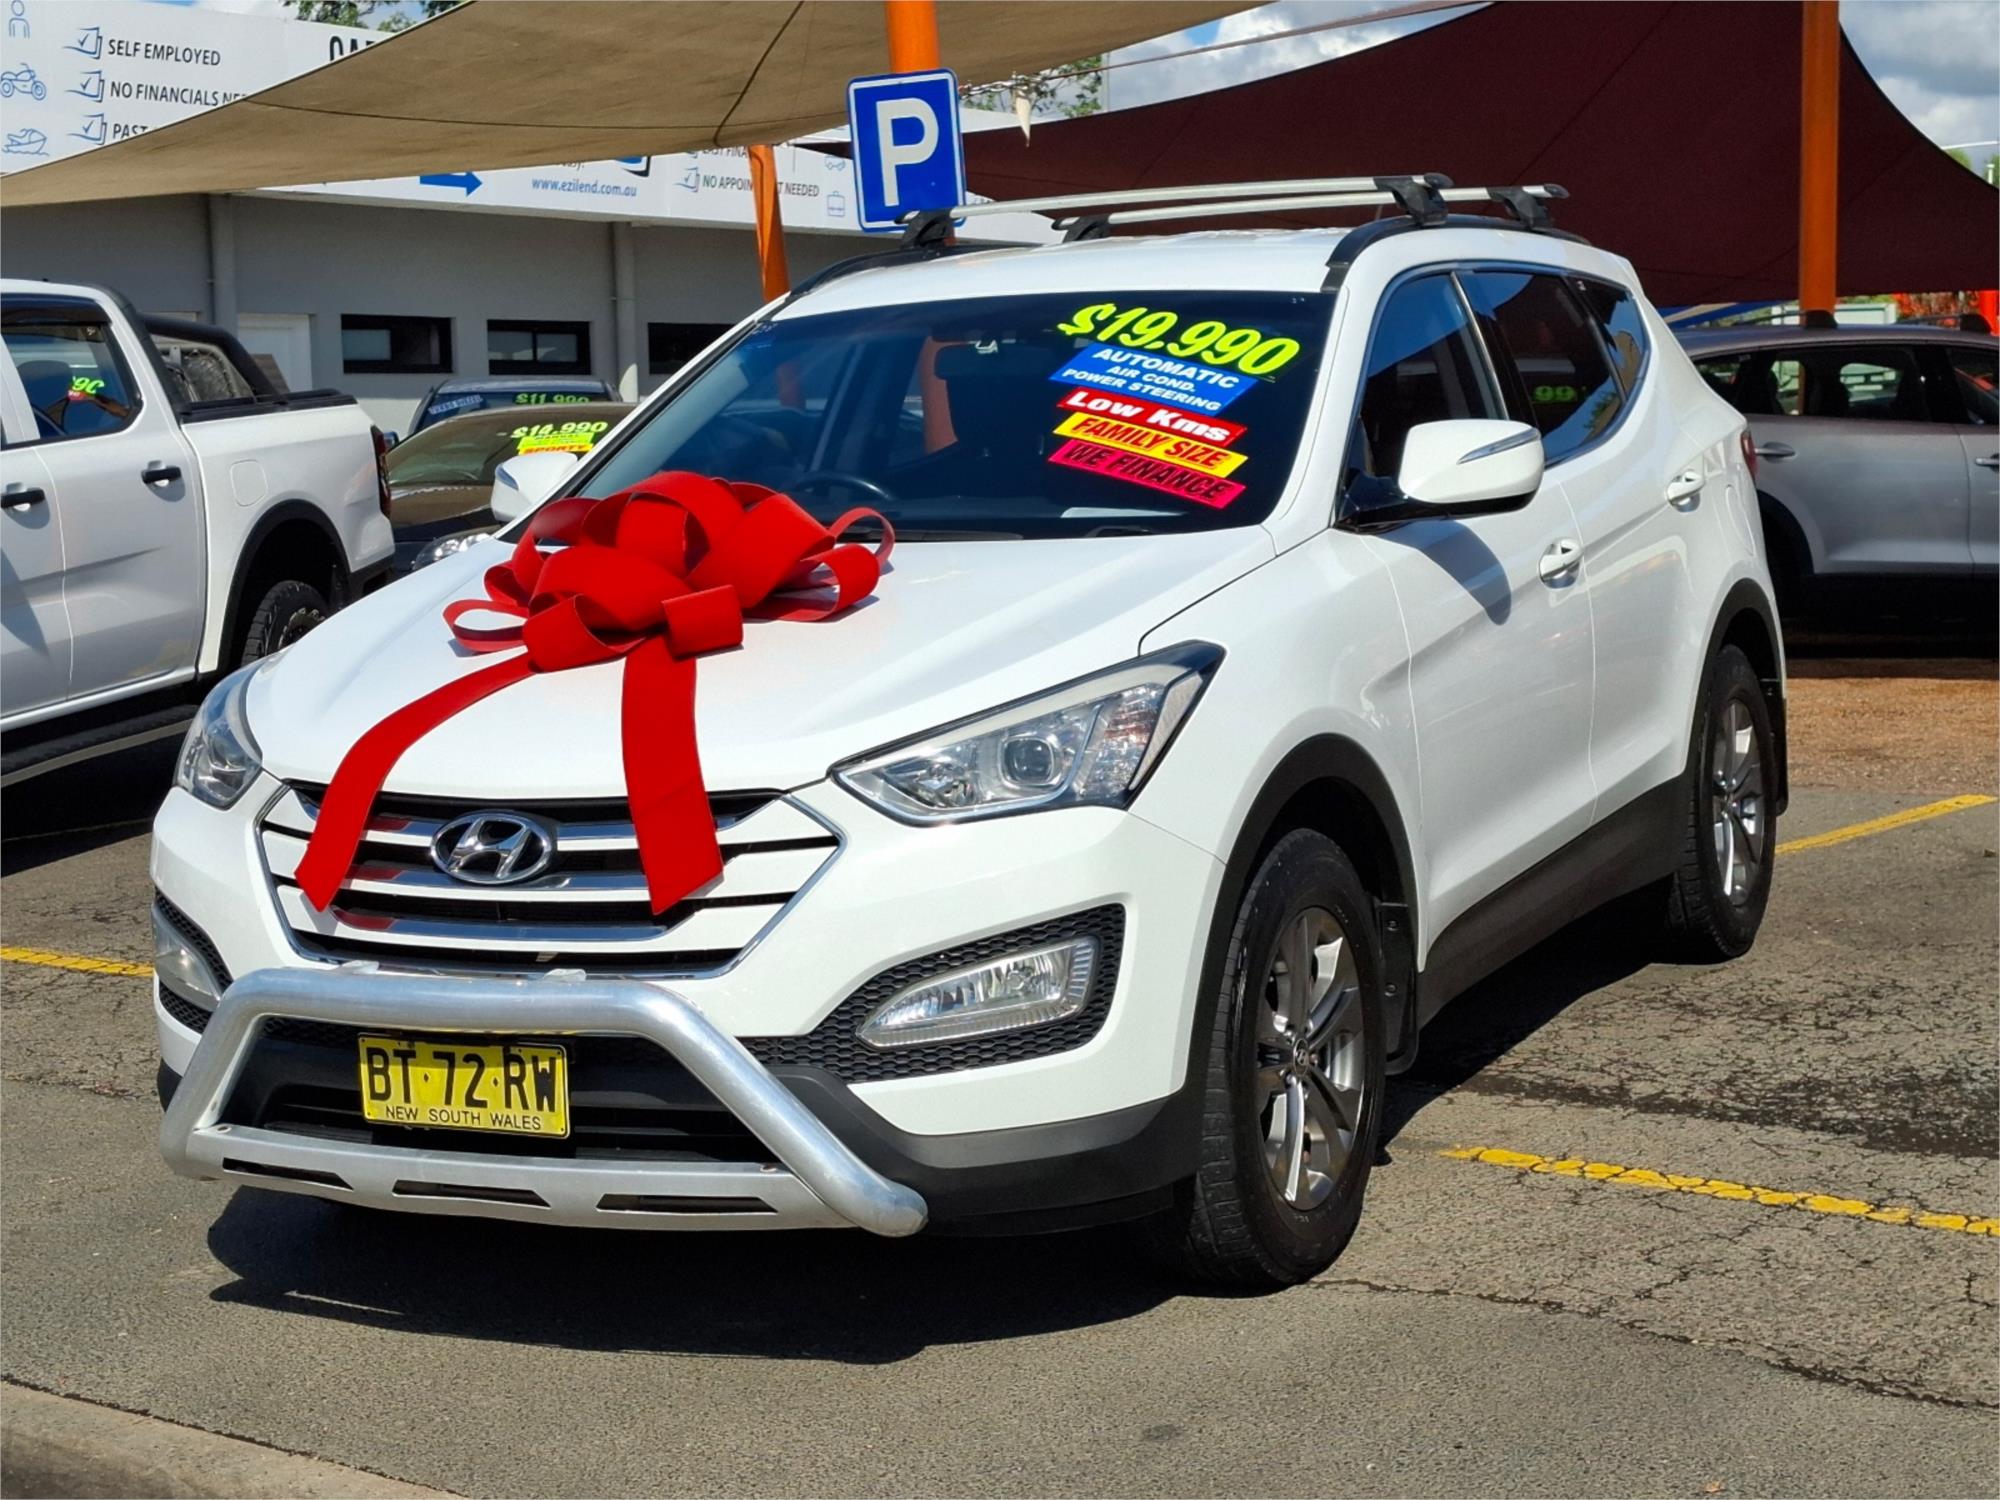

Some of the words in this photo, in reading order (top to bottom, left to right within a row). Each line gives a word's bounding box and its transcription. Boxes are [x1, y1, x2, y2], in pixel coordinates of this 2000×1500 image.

[108, 39, 141, 57] SELF
[144, 43, 221, 66] EMPLOYED
[110, 81, 133, 98] NO
[135, 84, 219, 106] FINANCIALS
[876, 97, 939, 207] P
[532, 179, 637, 196] www.ezilend.com.au
[702, 175, 717, 187] NO
[784, 182, 819, 197] NEEDED
[1093, 347, 1240, 389] AUTOMATIC
[1107, 365, 1139, 379] AIR
[1142, 371, 1196, 393] COND.
[1062, 368, 1125, 391] POWER
[1128, 381, 1222, 412] STEERING
[1071, 417, 1170, 451] FAMILY
[1164, 440, 1229, 470] SIZE
[1064, 442, 1114, 466] WE
[1105, 454, 1228, 500] FINANCE
[366, 1047, 417, 1104] BT
[433, 1051, 488, 1108] 72
[503, 1049, 556, 1112] RW
[385, 1106, 418, 1120] NEW
[429, 1109, 480, 1125] SOUTH
[490, 1112, 541, 1130] WALES
